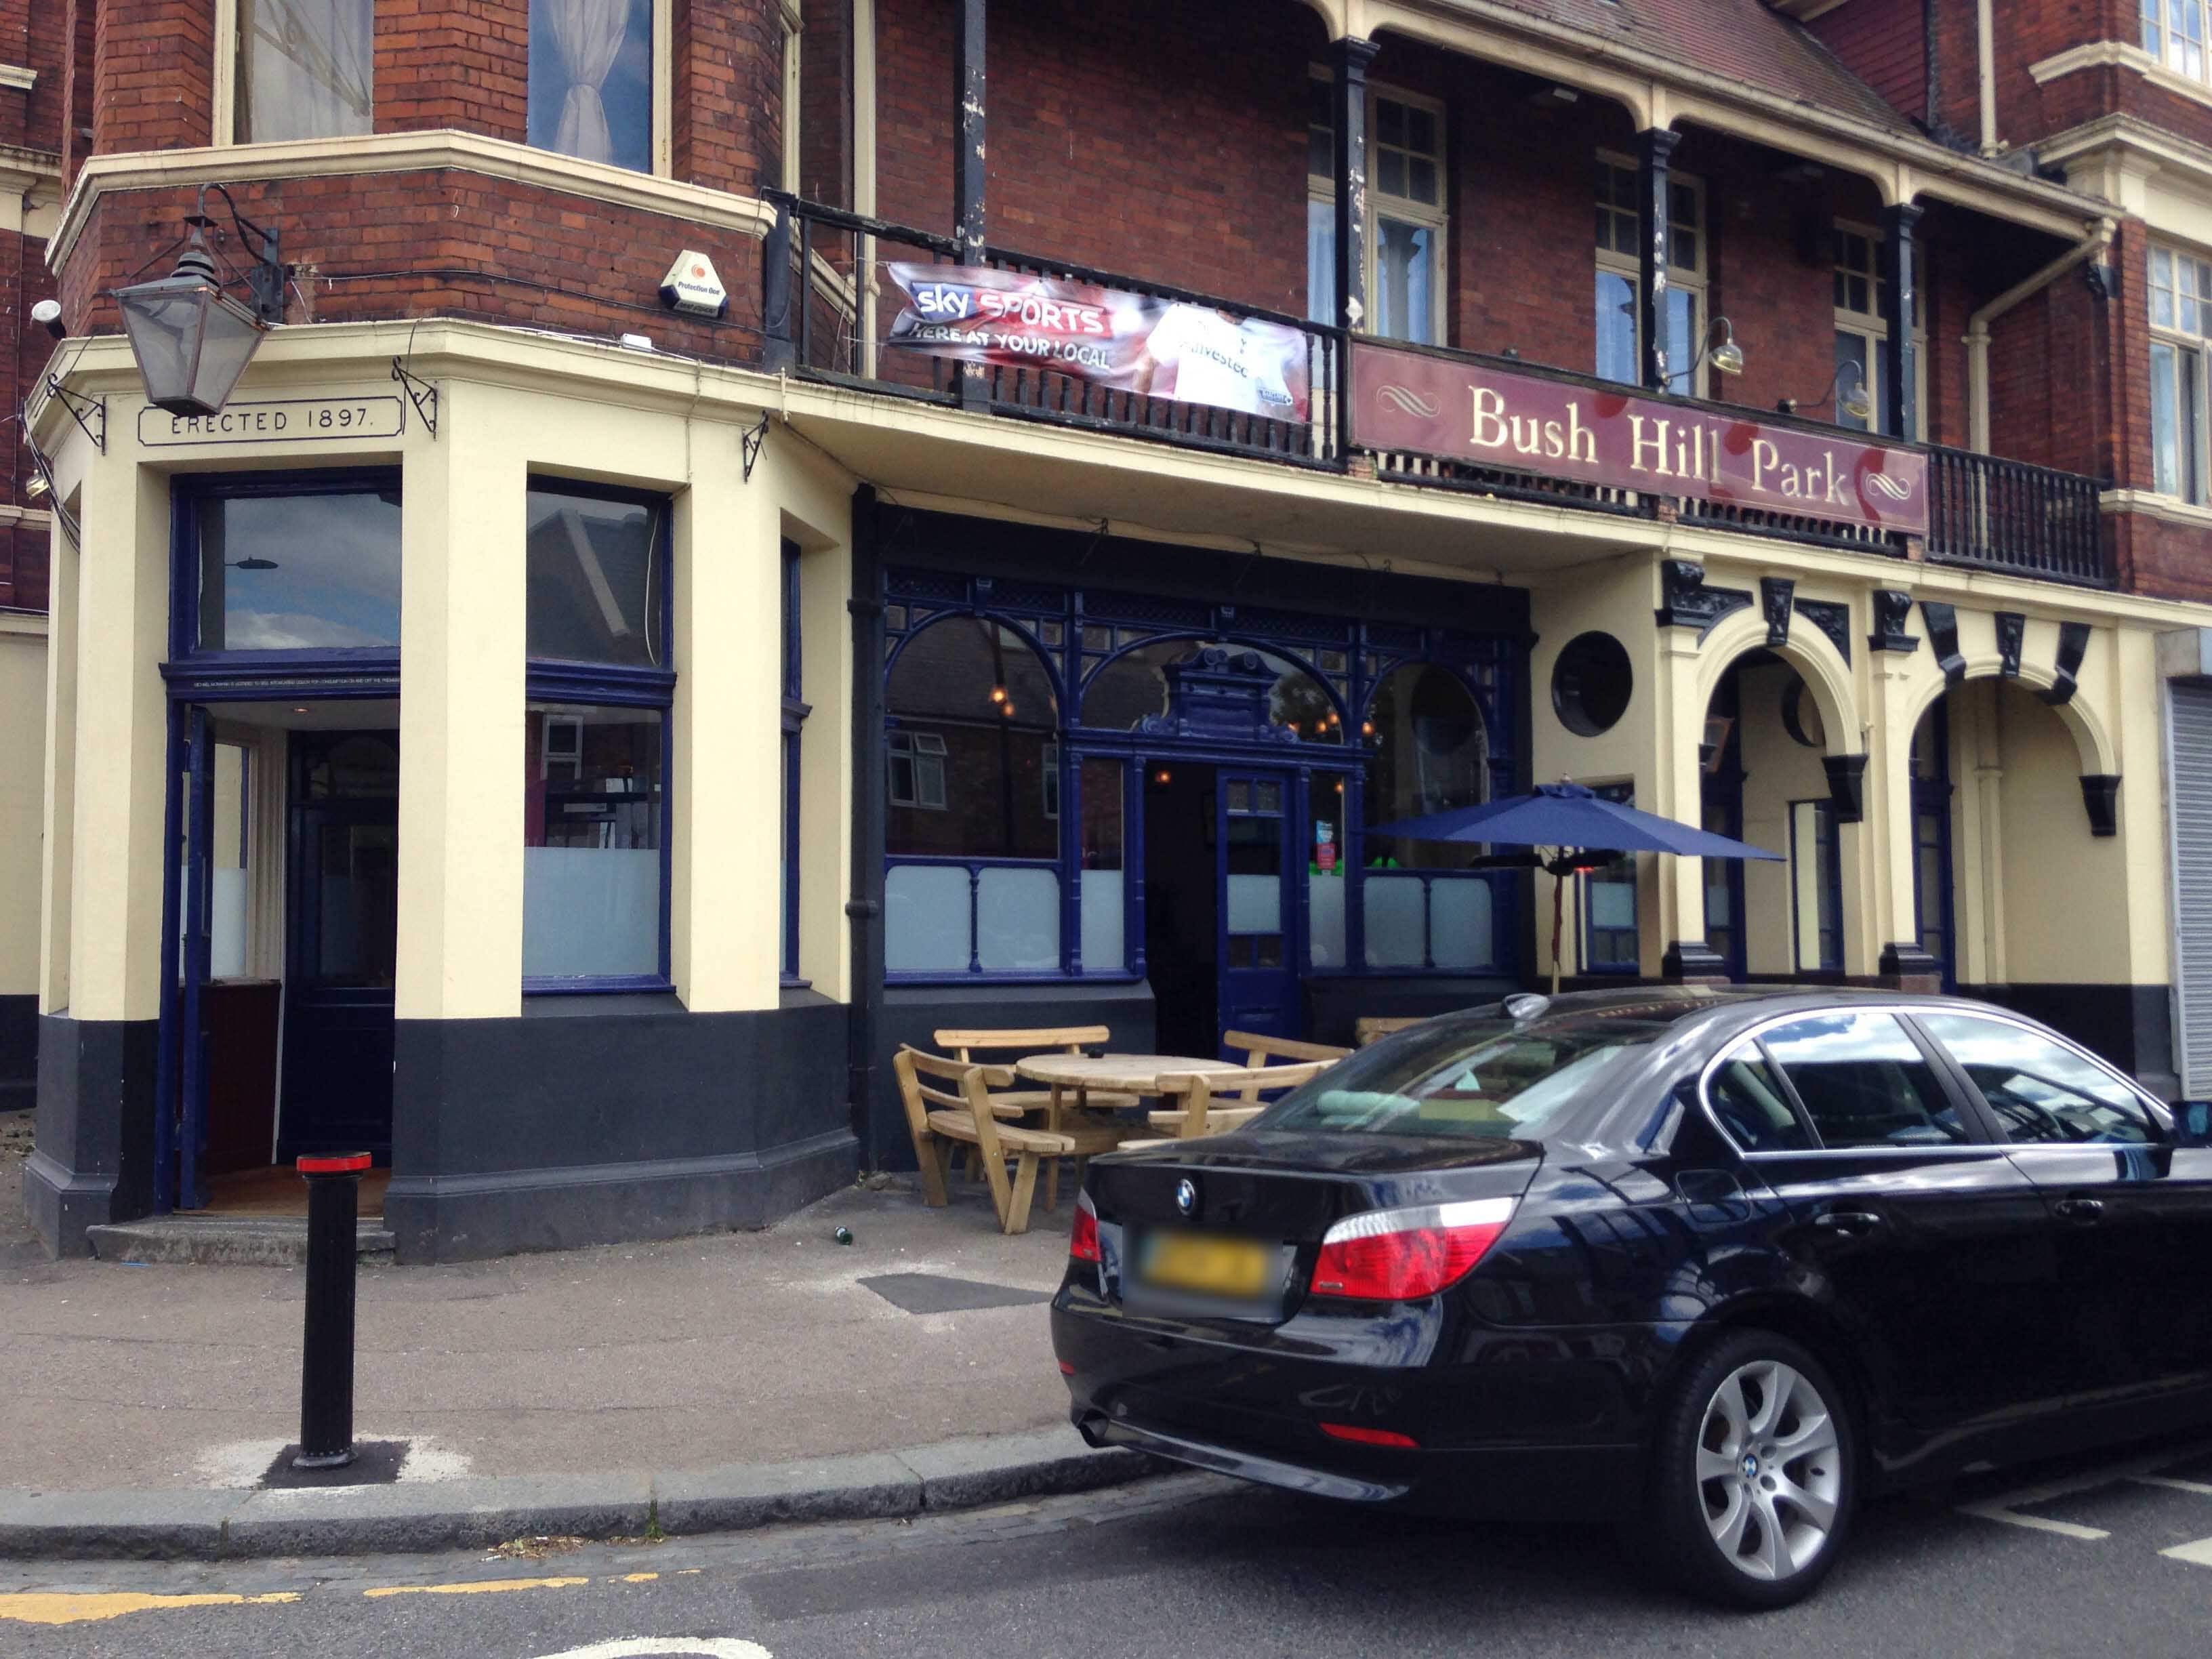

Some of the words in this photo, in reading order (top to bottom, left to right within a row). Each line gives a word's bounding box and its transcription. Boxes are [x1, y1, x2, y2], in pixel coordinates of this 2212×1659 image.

[918, 285, 968, 317] sky
[980, 293, 1103, 333] SPORTS
[911, 323, 961, 342] HERE
[966, 330, 990, 346] AT
[994, 333, 1050, 357] YOUR
[1052, 341, 1109, 369] LOCAL
[171, 411, 287, 434] ERECTED
[1469, 385, 1599, 464] Bush
[1627, 414, 1723, 484] Hill
[1749, 437, 1849, 506] Park
